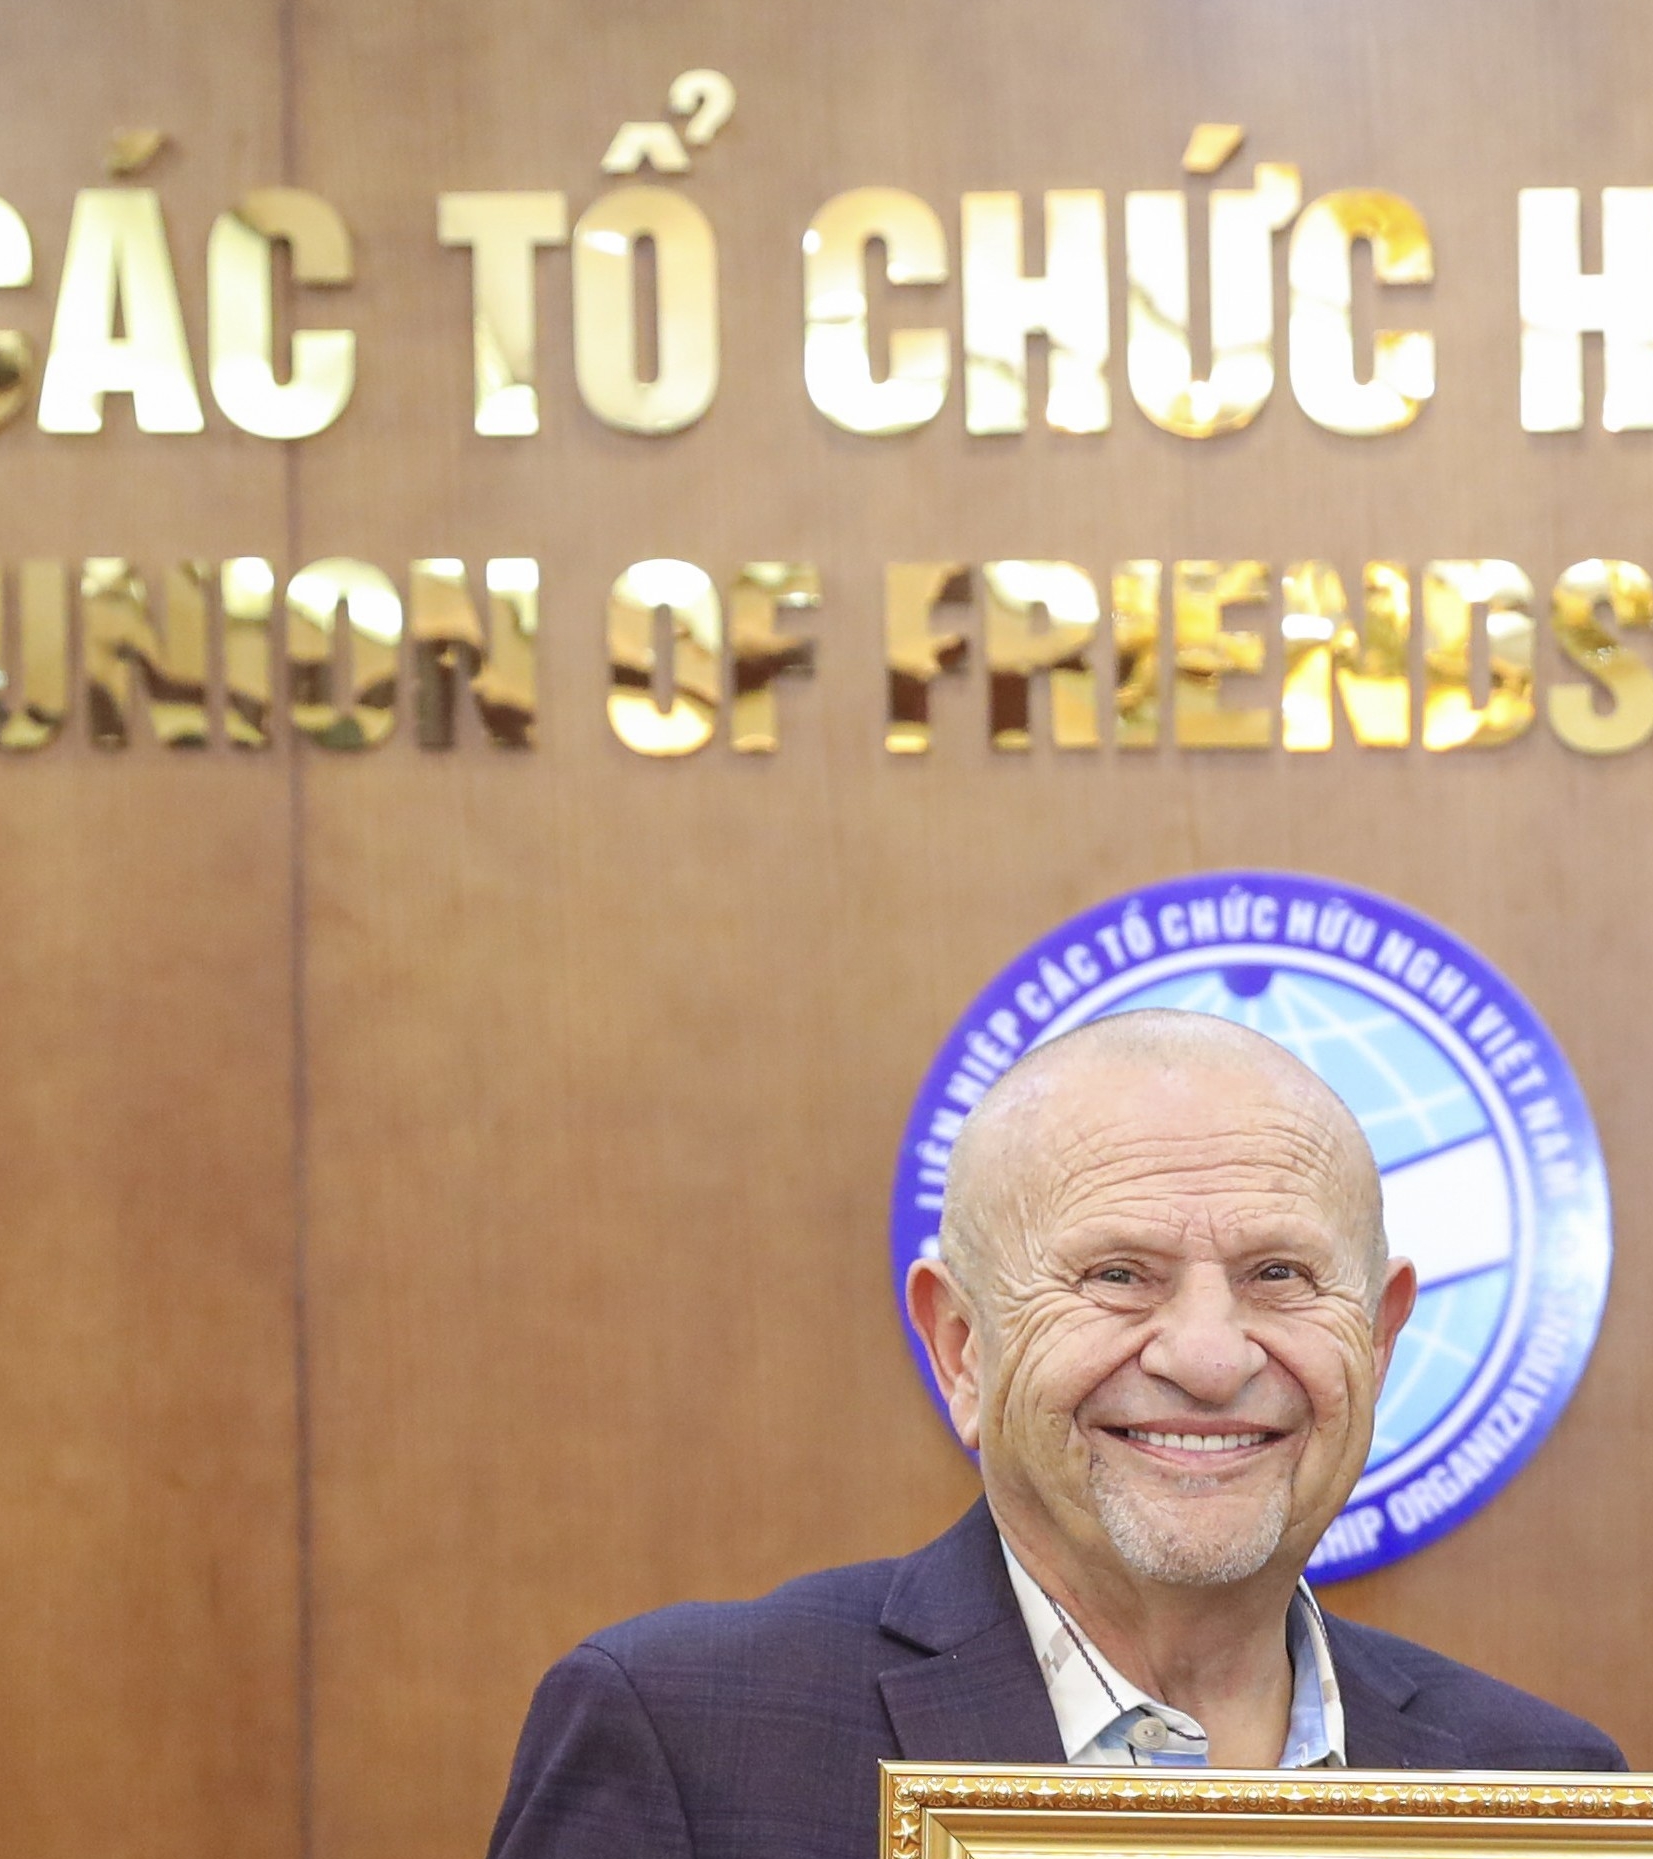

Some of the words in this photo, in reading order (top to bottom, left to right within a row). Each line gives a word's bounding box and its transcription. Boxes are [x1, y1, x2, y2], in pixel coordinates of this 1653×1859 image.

[436, 68, 736, 439] TỔ
[801, 121, 1436, 439] CHỨC
[605, 554, 821, 756] OF
[1014, 942, 1102, 1024] CÁC
[1157, 883, 1280, 949] CHỨC
[1285, 896, 1380, 961] HỮU
[1519, 1095, 1579, 1198] NAM
